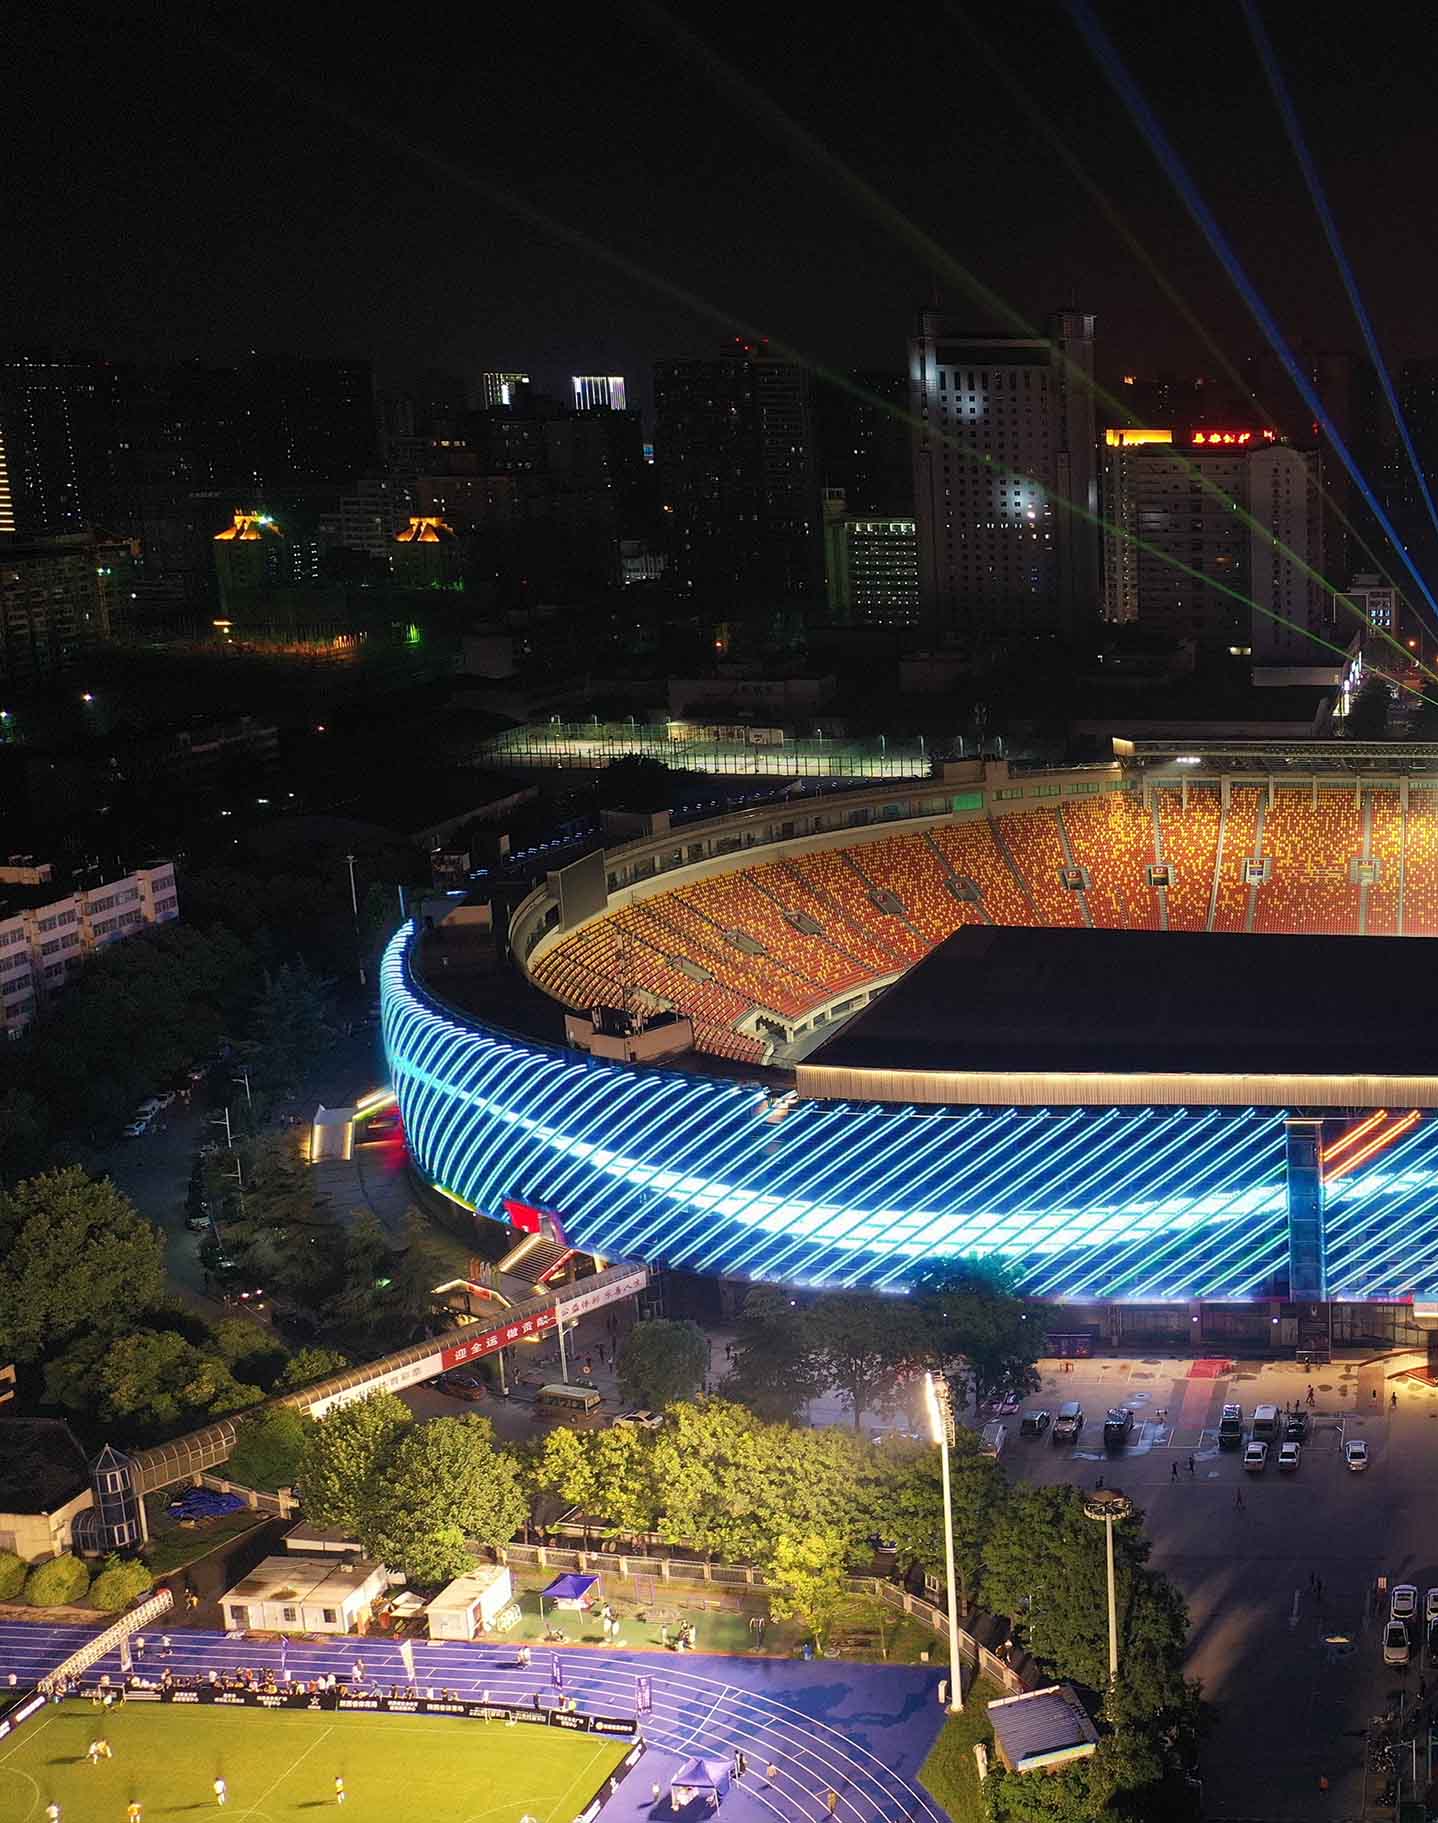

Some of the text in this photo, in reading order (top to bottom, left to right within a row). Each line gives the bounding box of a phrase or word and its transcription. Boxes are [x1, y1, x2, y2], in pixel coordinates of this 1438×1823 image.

[454, 1314, 550, 1361] 迎全运 做贡献
